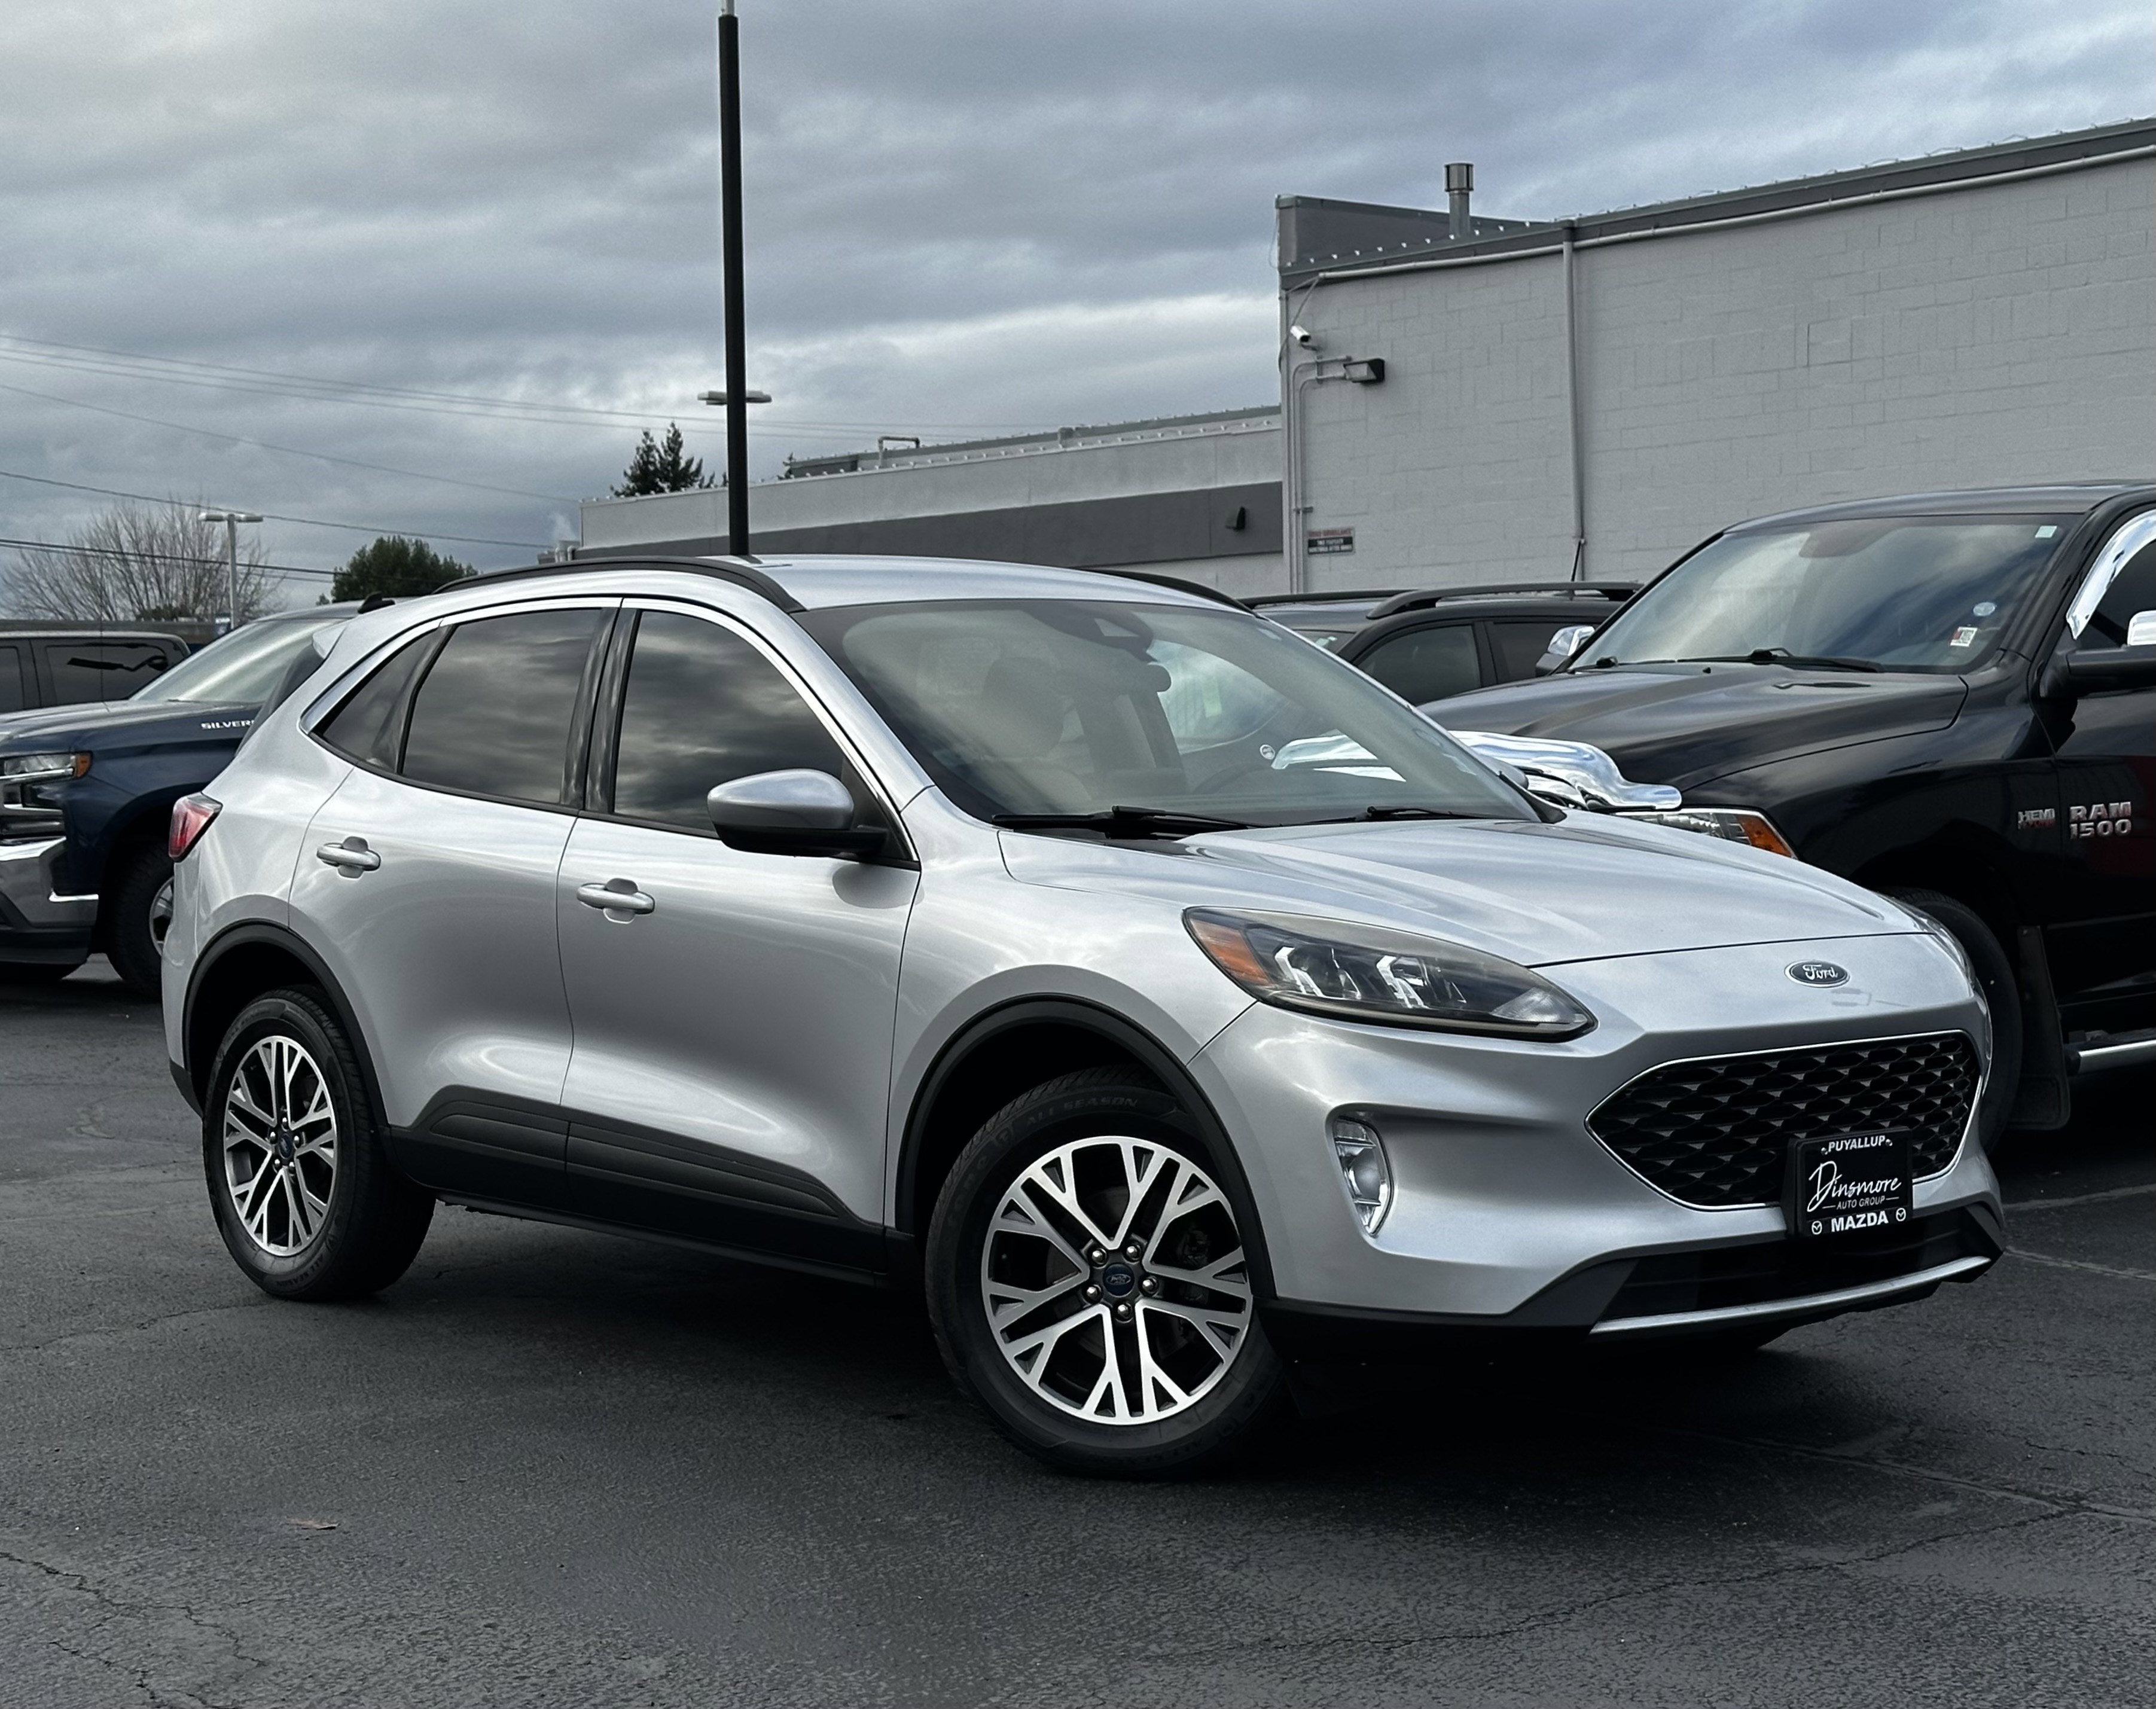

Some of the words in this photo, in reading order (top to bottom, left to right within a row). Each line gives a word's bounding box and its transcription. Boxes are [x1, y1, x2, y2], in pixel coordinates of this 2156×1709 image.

[2018, 808, 2056, 822] HEMI
[2070, 801, 2131, 822] RAM
[2070, 819, 2132, 839] 1500
[1802, 964, 1838, 980] Ford
[1828, 1135, 1886, 1152] PUYALLUP
[1807, 1161, 1901, 1212] Dinsmore
[1837, 1198, 1857, 1210] AUTO
[1859, 1195, 1885, 1207] GROUP
[1831, 1210, 1889, 1232] MAZDA
